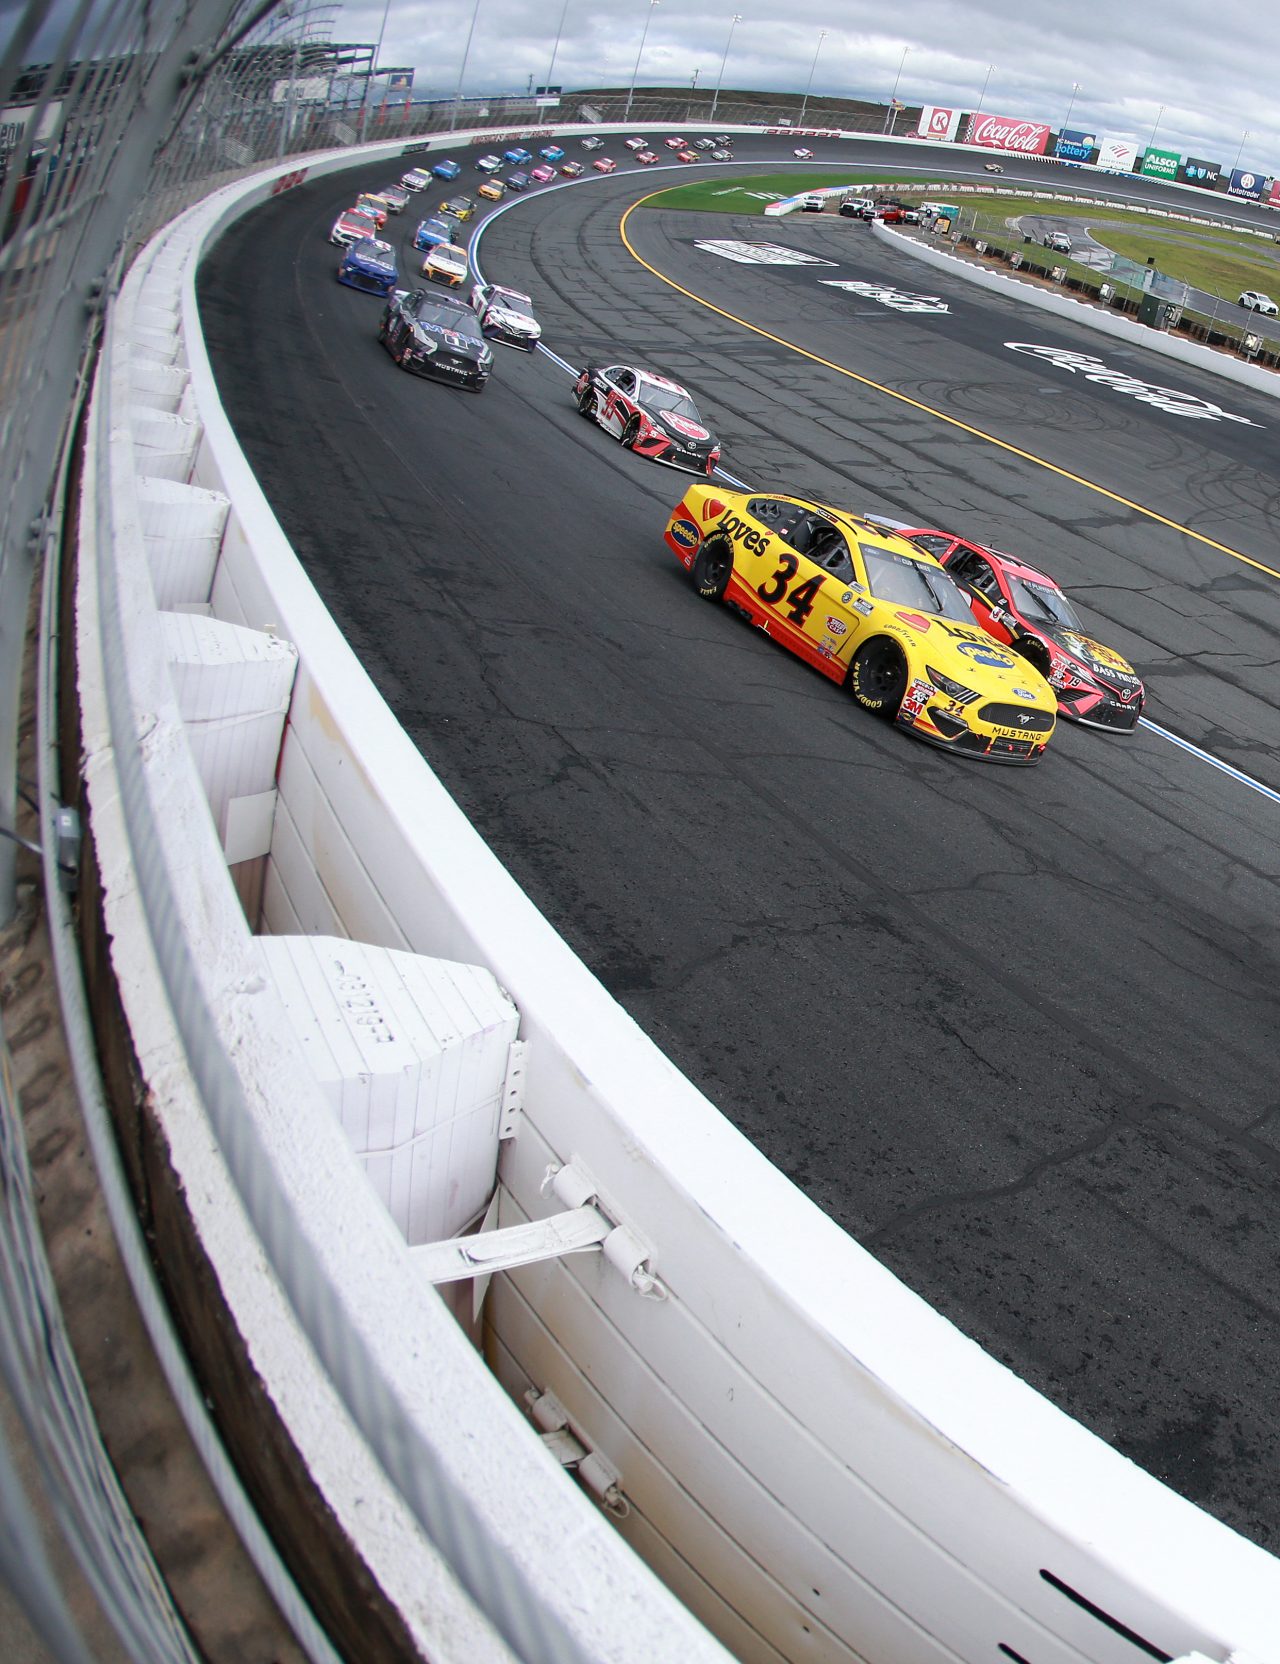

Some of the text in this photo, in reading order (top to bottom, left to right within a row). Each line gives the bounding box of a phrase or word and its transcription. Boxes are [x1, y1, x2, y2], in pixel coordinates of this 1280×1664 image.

[1054, 142, 1092, 160] Lottery
[1146, 154, 1178, 168] ALSCO
[1144, 163, 1175, 175] UNIFORMS
[1206, 171, 1219, 181] NC
[1227, 186, 1260, 199] Autotrader
[435, 361, 468, 377] MUSTANG
[673, 522, 698, 546] speedco
[902, 558, 913, 567] CUP
[758, 553, 828, 630] 34
[1092, 663, 1116, 678] BASS
[852, 661, 883, 710] GOODYEAR
[1068, 676, 1081, 687] 19
[903, 698, 924, 716] 3M
[943, 700, 966, 718] 34
[1110, 700, 1137, 711] CAMRY
[992, 726, 1043, 741] MUSTANG
